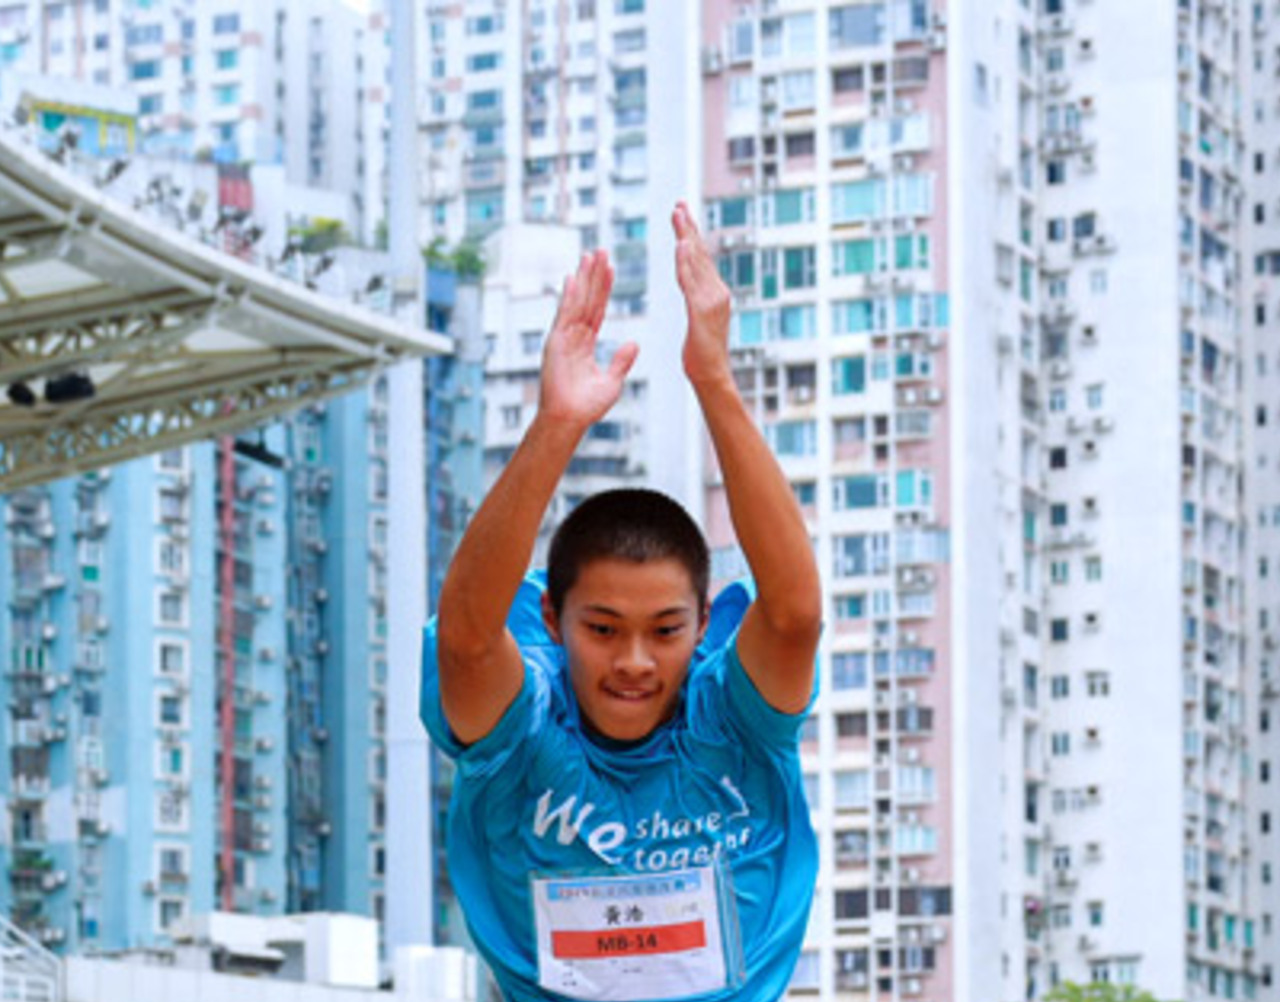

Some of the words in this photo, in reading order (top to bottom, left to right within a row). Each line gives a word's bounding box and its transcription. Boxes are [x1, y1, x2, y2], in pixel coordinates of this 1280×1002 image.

[533, 788, 628, 865] We
[635, 810, 722, 840] share
[597, 934, 659, 953] MB-14
